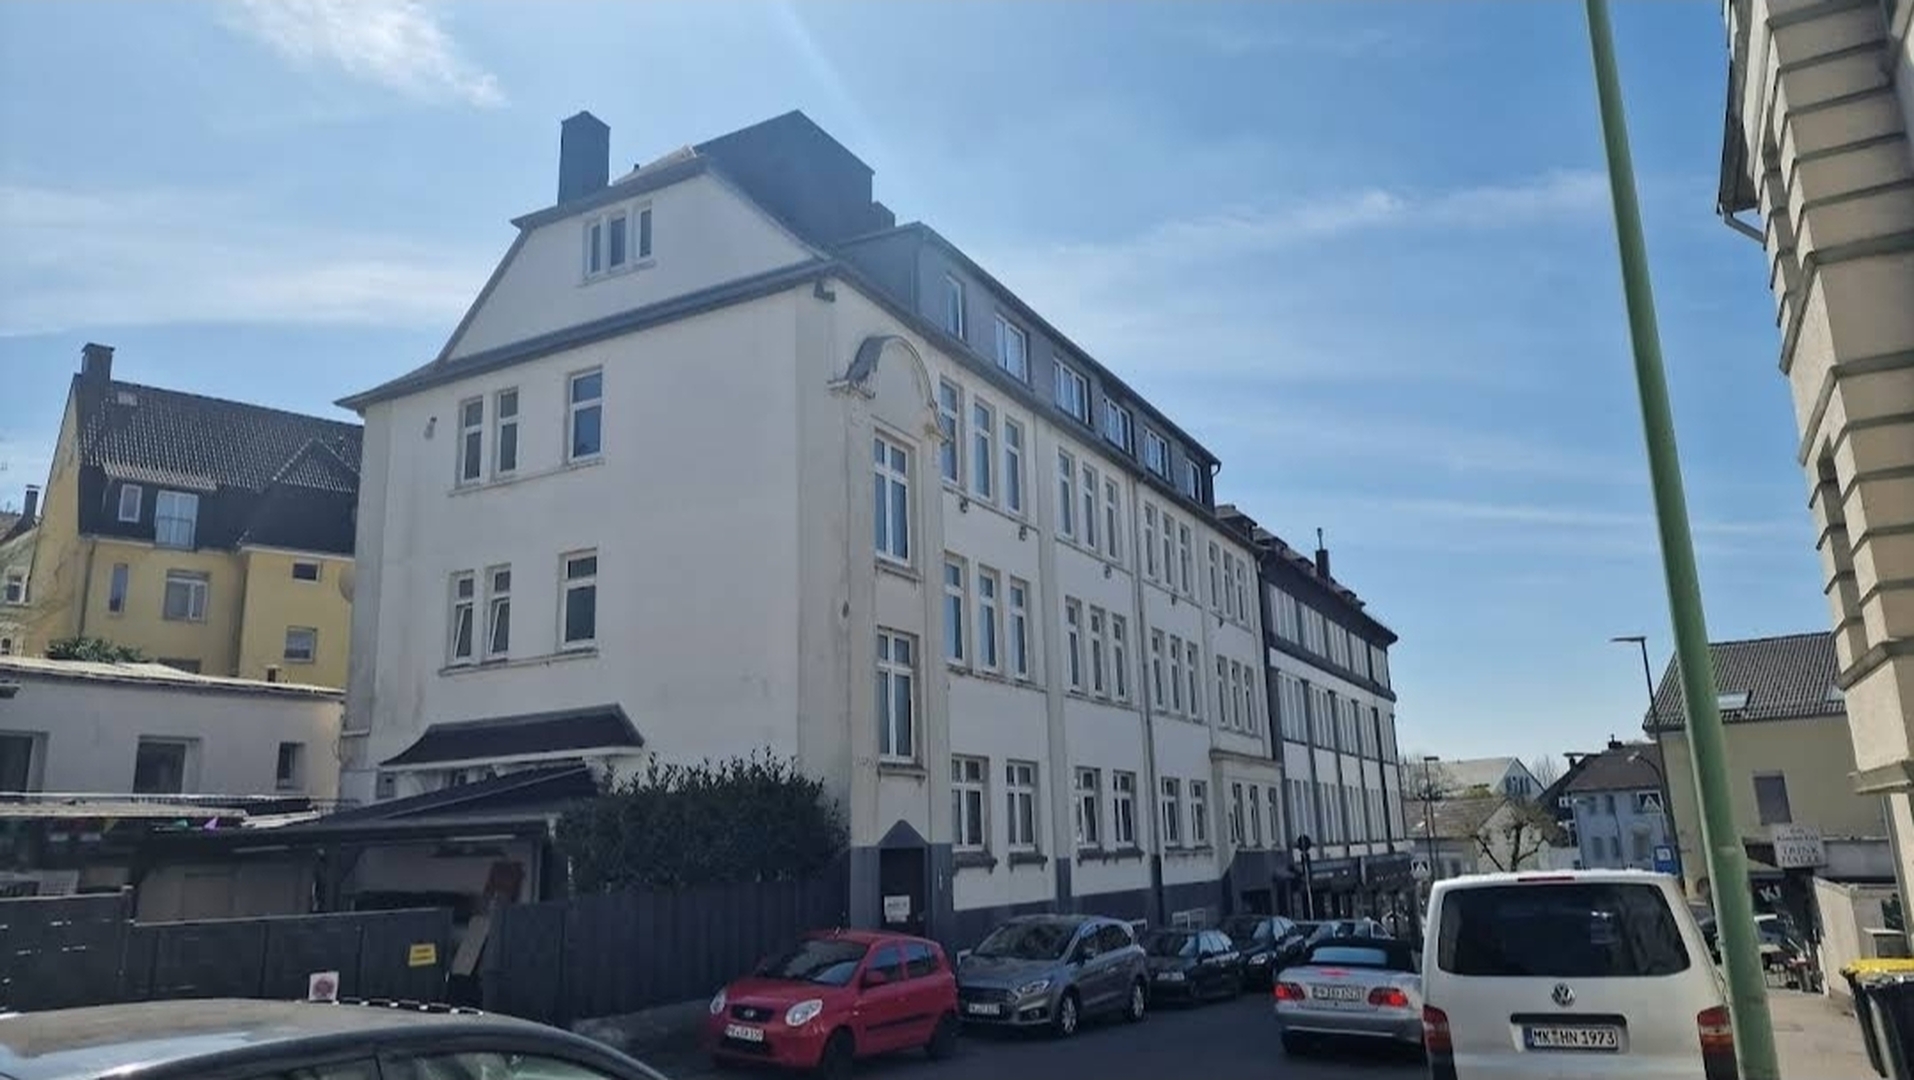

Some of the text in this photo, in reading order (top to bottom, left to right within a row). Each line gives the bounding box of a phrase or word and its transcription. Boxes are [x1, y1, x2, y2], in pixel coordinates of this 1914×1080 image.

[1533, 1030, 1615, 1045] MK HN 1973
